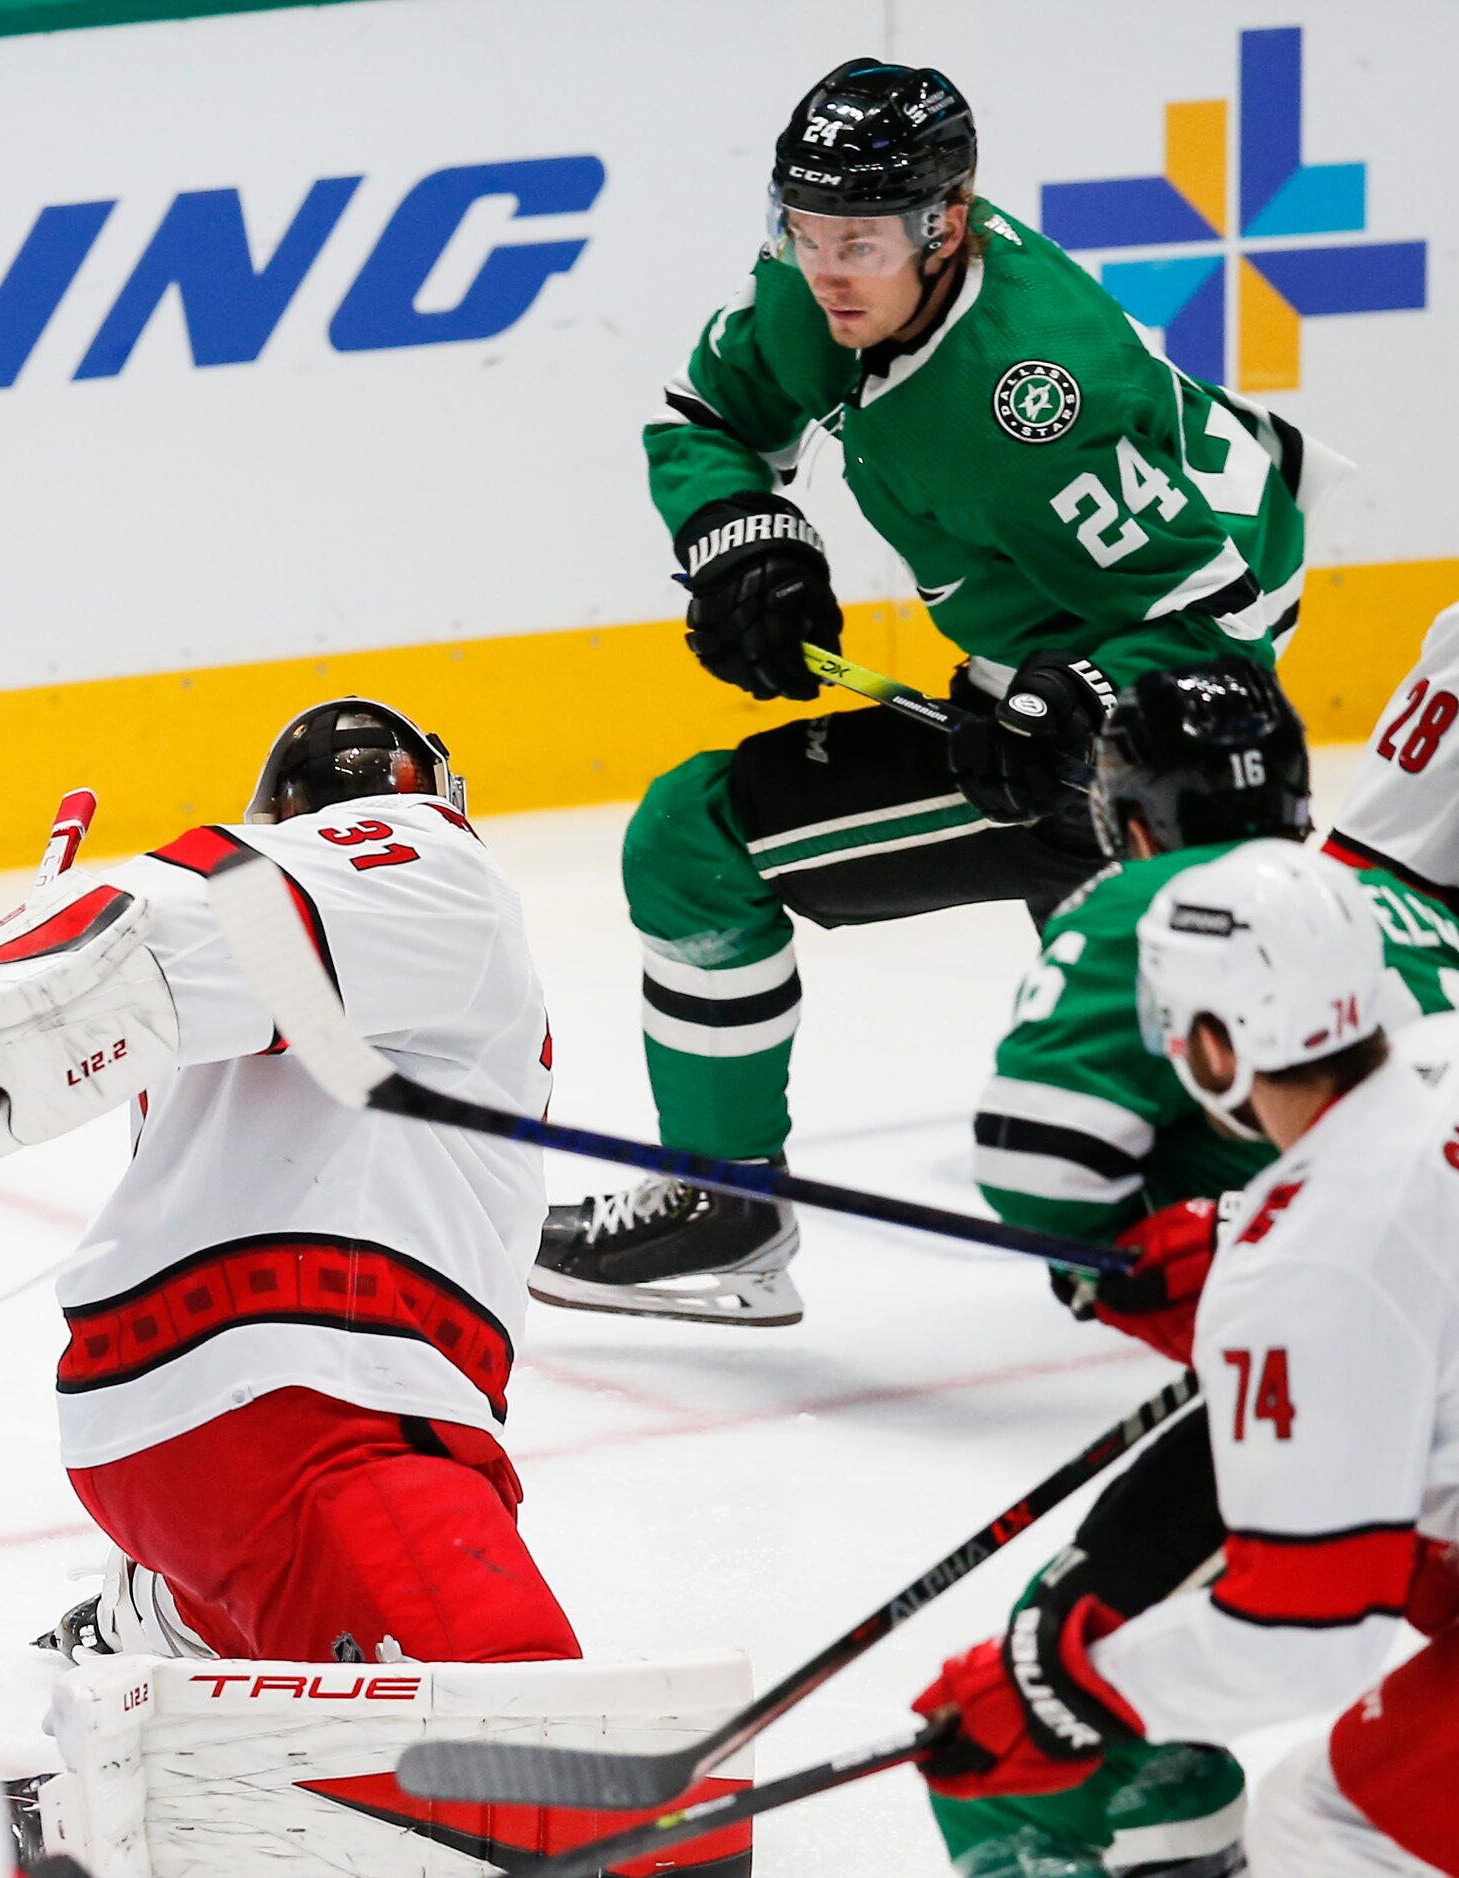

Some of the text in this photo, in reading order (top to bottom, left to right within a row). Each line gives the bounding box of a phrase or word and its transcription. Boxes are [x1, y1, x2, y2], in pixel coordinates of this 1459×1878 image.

[802, 116, 843, 147] 24
[789, 165, 842, 186] CCM
[1000, 366, 1076, 437] DALLAS STARS
[1049, 435, 1188, 569] 24
[1377, 678, 1459, 774] 28
[1230, 750, 1267, 790] 16
[318, 820, 421, 871] 31
[1332, 993, 1359, 1038] 74
[67, 1038, 128, 1087] L12.2
[1222, 1347, 1297, 1442] 74
[890, 1540, 990, 1628] ALPHA
[123, 1682, 149, 1712] L12.2
[189, 1675, 422, 1700] TRUE
[1012, 1607, 1102, 1749] BAUER
